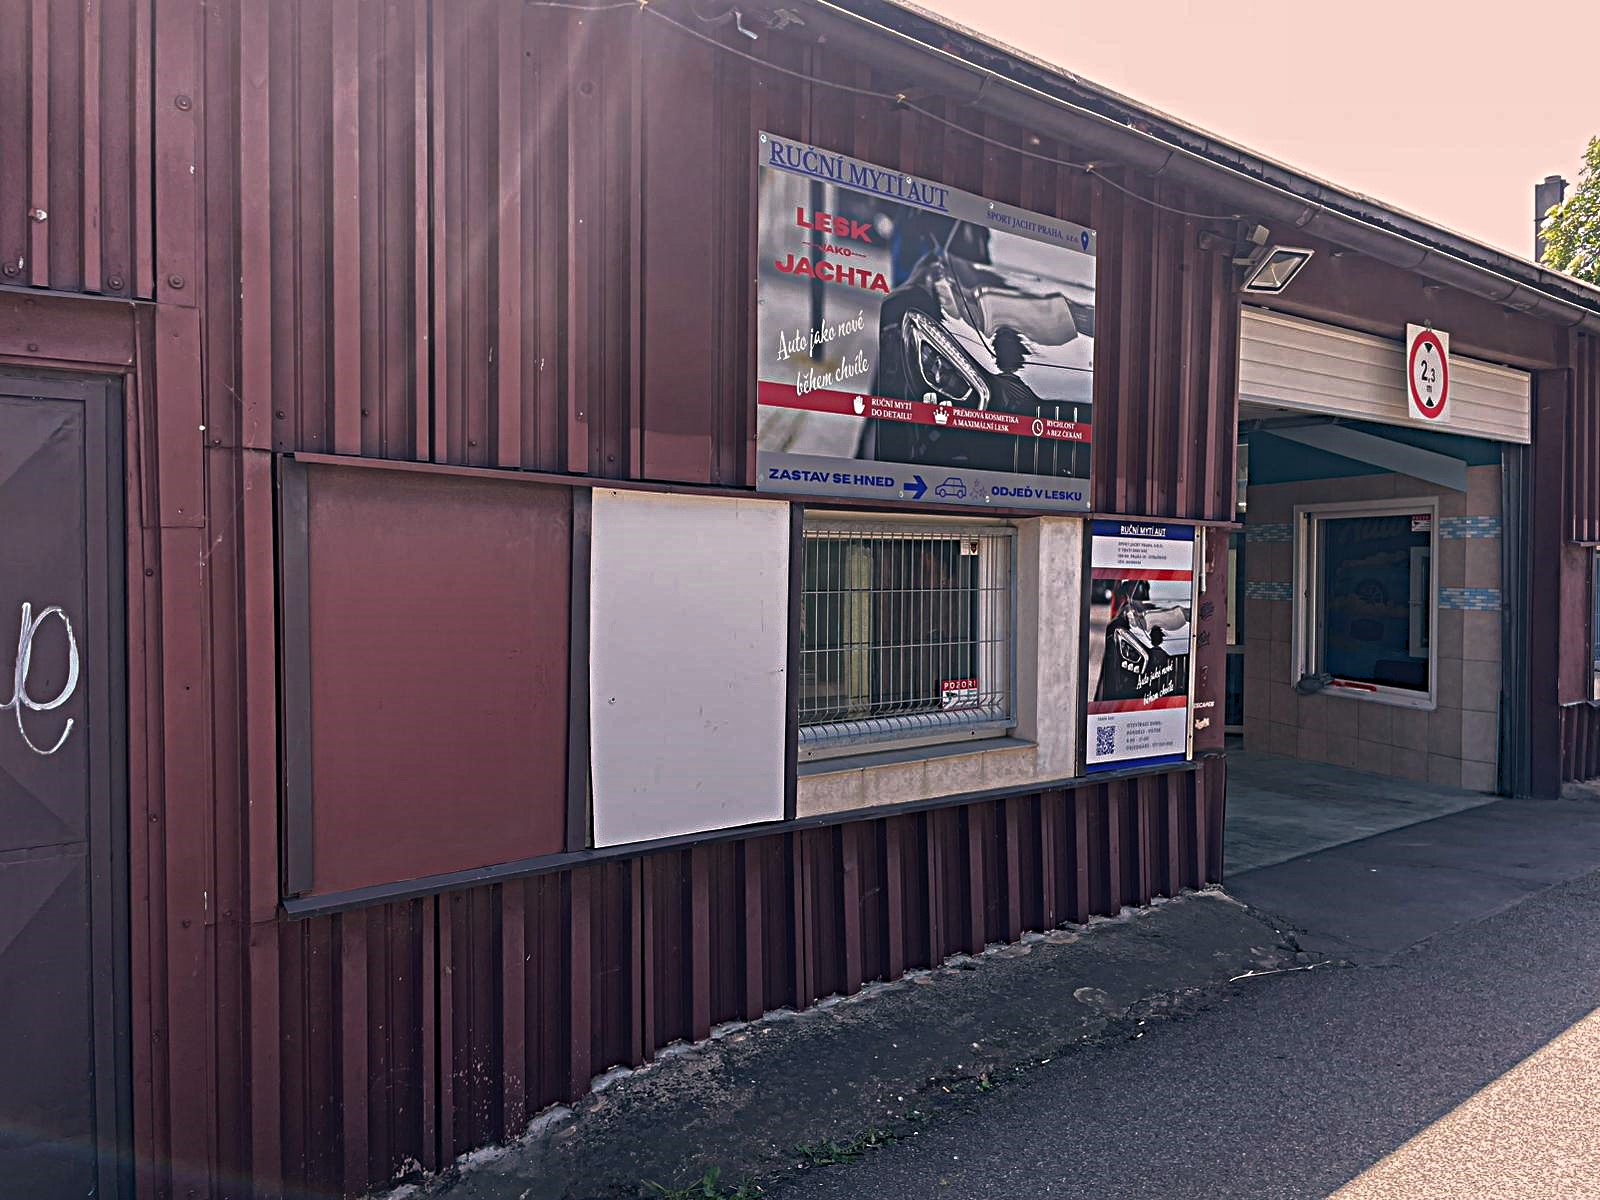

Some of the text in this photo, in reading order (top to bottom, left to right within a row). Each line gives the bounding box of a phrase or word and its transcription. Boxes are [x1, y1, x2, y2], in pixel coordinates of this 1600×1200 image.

[769, 140, 949, 208] RUČNÍ MYTÍ AUT
[796, 207, 872, 243] LESK
[987, 210, 1011, 225] SPORT
[1012, 218, 1036, 233] JACHT
[822, 244, 852, 256] JAKO
[775, 254, 890, 293] JACHTA
[777, 310, 865, 360] Auto jako nové
[796, 367, 833, 396] během
[1421, 360, 1436, 383] 2,3
[871, 398, 912, 410] RUČNÍ MYTÍ
[871, 408, 882, 417] DO
[994, 423, 1009, 432] LESK
[769, 468, 895, 487] ZASTAV SE HNED
[991, 485, 1082, 501] ODJEĎ V LESKU
